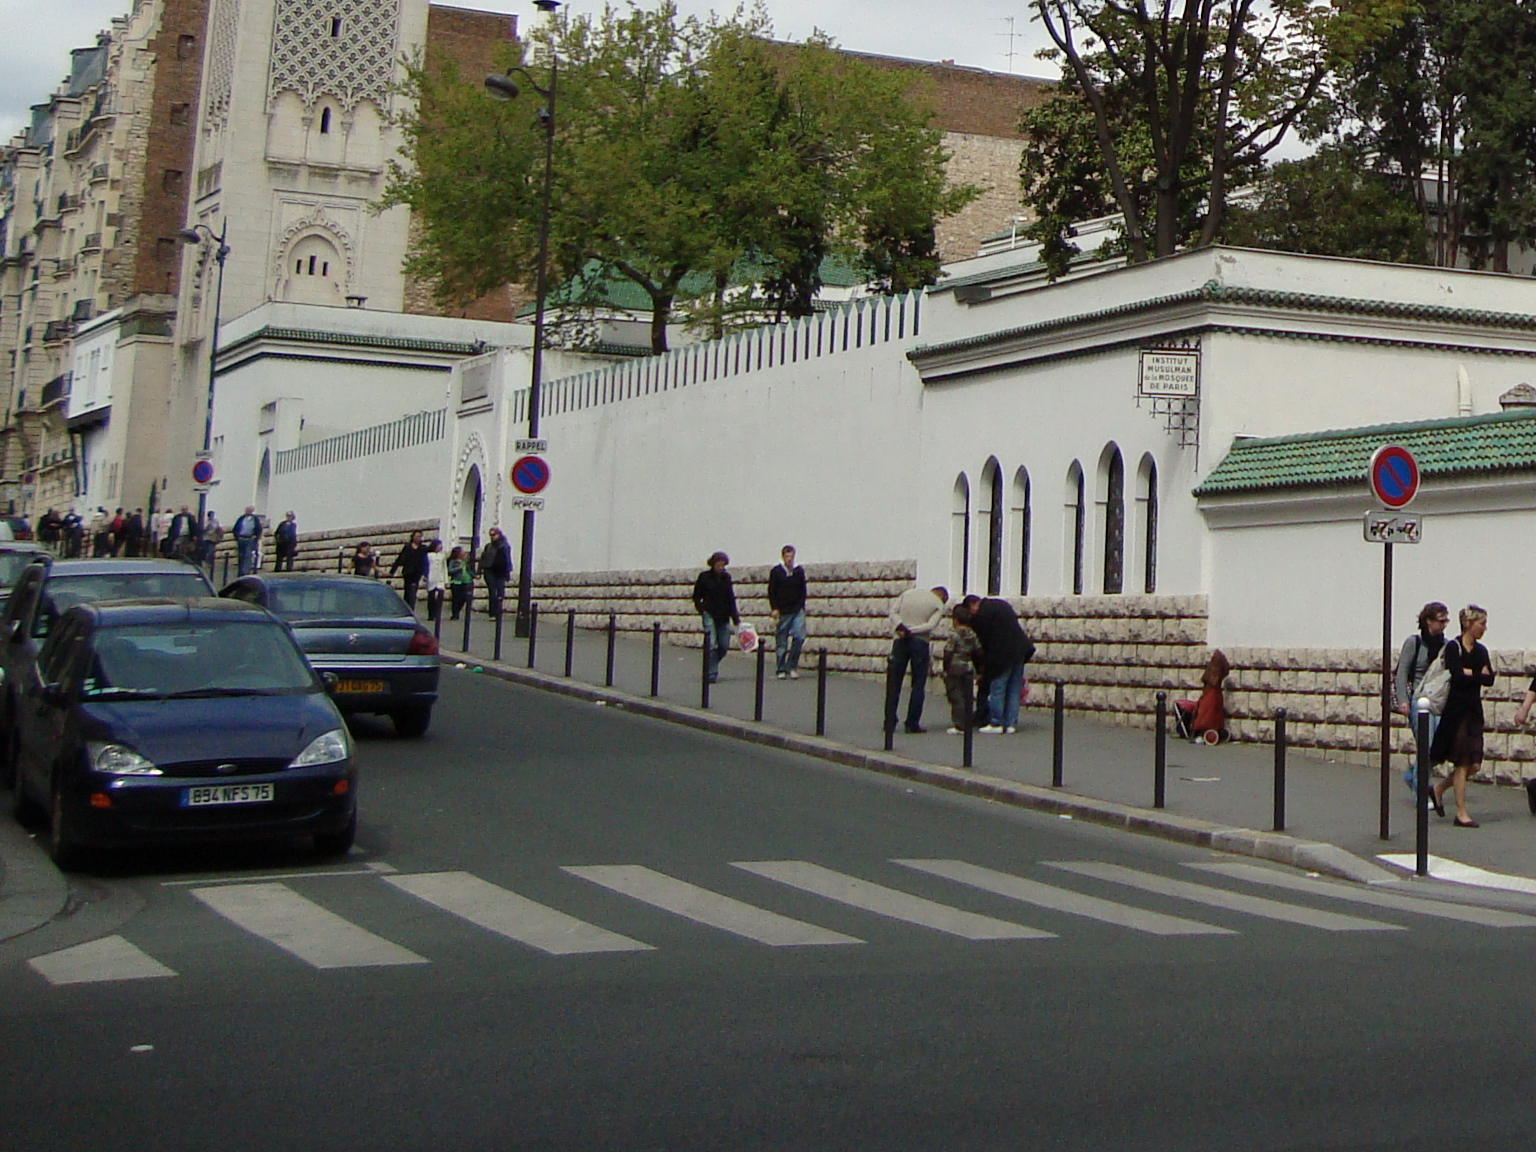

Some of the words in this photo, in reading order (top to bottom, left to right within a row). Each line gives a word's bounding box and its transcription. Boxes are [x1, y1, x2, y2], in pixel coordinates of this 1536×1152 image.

[1152, 357, 1188, 365] INSTITUT
[1147, 365, 1192, 373] MUSULMAN
[1150, 382, 1159, 390] DE
[1163, 383, 1188, 391] PARIS
[516, 440, 545, 451] RAPPEL
[193, 789, 219, 803] 894
[223, 787, 249, 801] NFS
[252, 785, 269, 799] 75
